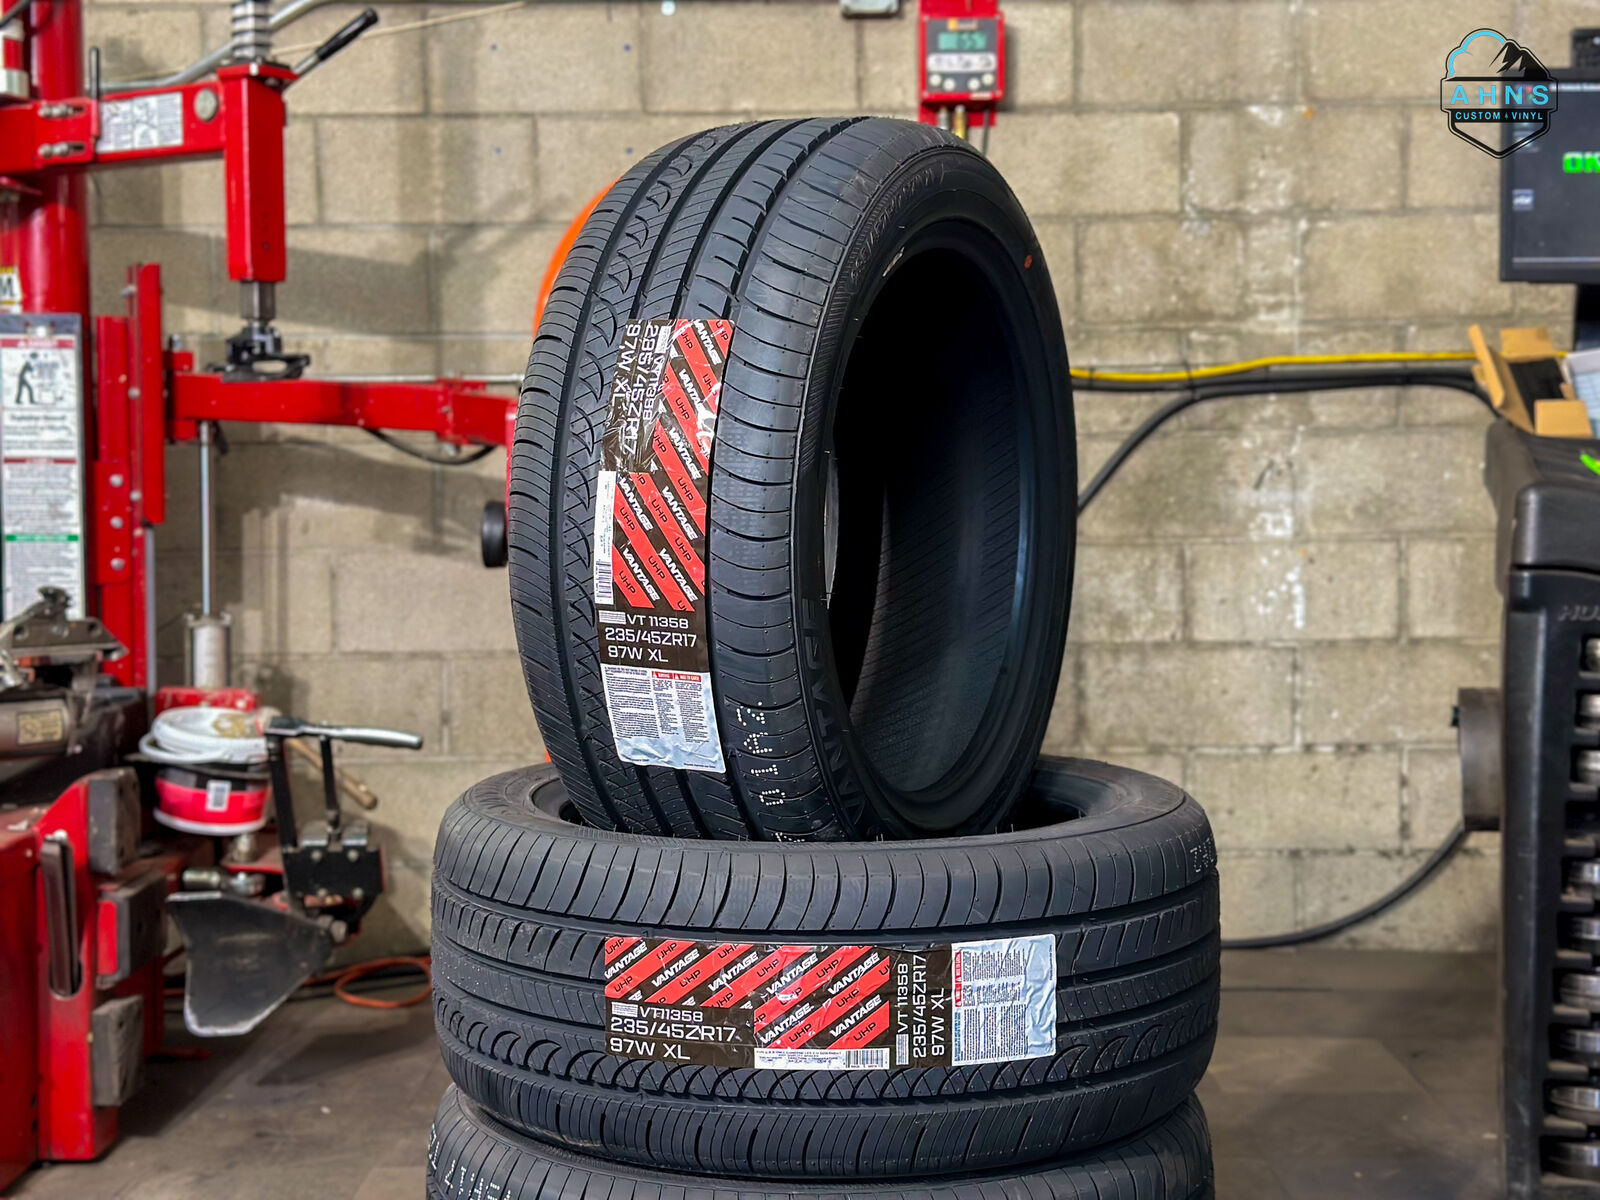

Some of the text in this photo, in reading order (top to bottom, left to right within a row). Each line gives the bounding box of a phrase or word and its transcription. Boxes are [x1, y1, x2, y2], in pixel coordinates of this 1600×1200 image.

[675, 397, 690, 421] UHP
[668, 426, 702, 481] VANTAGE
[618, 478, 654, 532] VANTAGE
[677, 476, 694, 502] UHP
[651, 498, 692, 562] UHP UHP
[661, 485, 699, 541] VANTAGE
[619, 506, 666, 580] UHP UHP
[618, 570, 636, 594] UHP
[622, 547, 661, 601] VANTAGE
[657, 547, 699, 602] VANTAGE
[604, 627, 697, 648] 235/45ZR17
[626, 614, 647, 626] VT
[648, 615, 689, 630] 11358
[608, 645, 669, 662] 97W XL
[603, 940, 648, 980] VANTAGE
[605, 937, 625, 955] UHP
[613, 942, 677, 993] UHP UHP
[651, 948, 700, 988] VANTAGE
[679, 969, 701, 988] UHP
[707, 950, 759, 992] VANTAGE
[756, 958, 780, 978] UHP
[765, 952, 819, 996] VANTAGE
[815, 959, 840, 979] UHP
[827, 951, 880, 996] VANTAGE
[897, 963, 909, 1007] 11358
[760, 1002, 814, 1045] VANTAGE
[788, 987, 860, 1043] UHP UHP
[829, 993, 883, 1037] VANTAGE
[897, 1011, 909, 1033] VT
[912, 954, 928, 1059] 235/45ZR17
[930, 987, 945, 1057] 97W XL
[609, 1037, 692, 1061] 97W XL
[610, 1016, 737, 1043] 235/45ZR17
[853, 1021, 877, 1042] UHP
